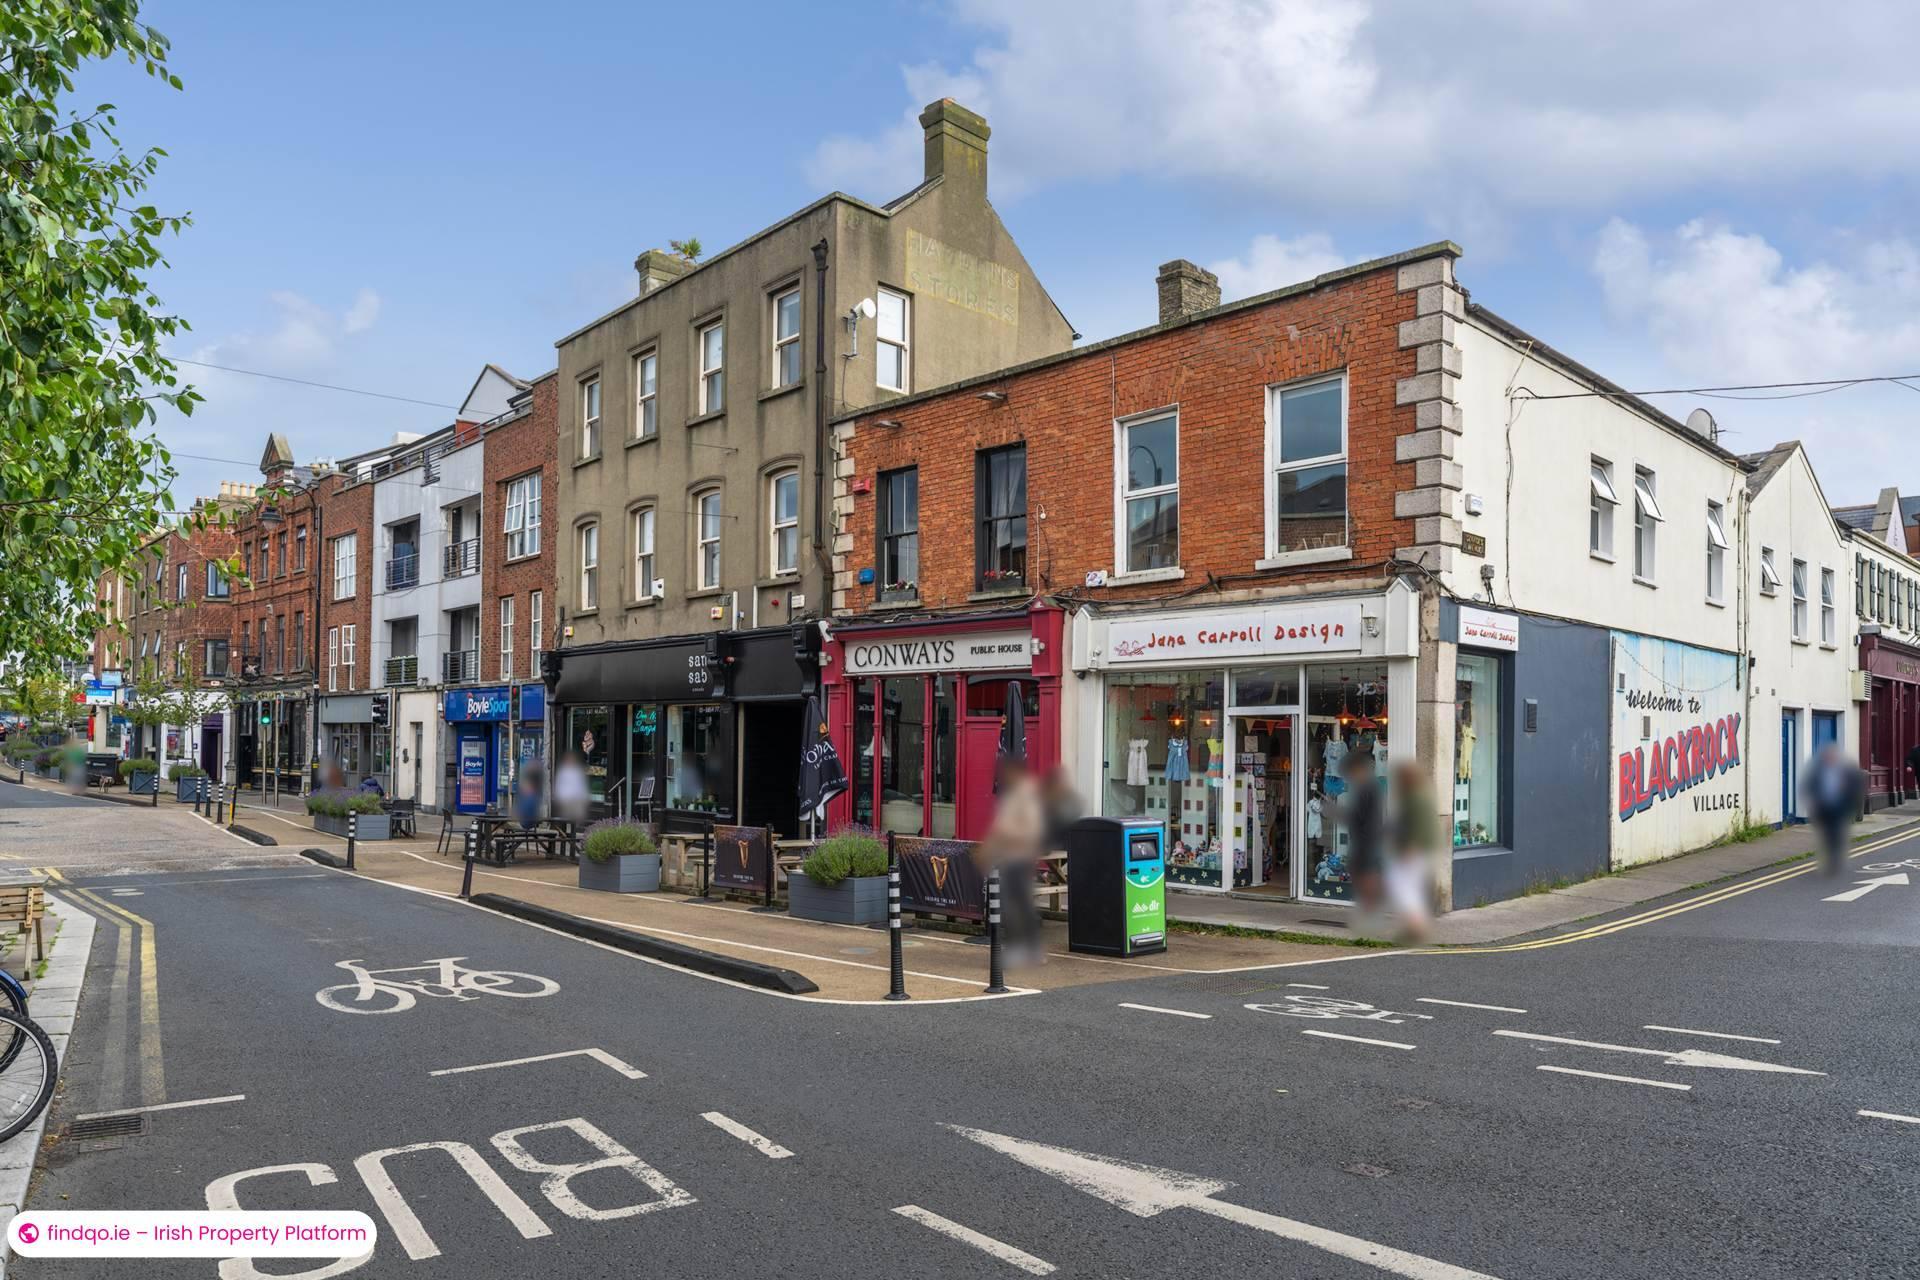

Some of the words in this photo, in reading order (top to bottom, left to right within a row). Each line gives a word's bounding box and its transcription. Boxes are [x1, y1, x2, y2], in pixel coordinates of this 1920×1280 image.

[911, 271, 1015, 322] STORES
[1198, 626, 1261, 644] Carroll
[1274, 623, 1344, 644] Design
[854, 640, 954, 668] CONWAYS
[970, 646, 996, 655] PUBLIC
[998, 644, 1023, 653] HOUSE
[467, 697, 509, 717] BoyleSpor
[1625, 689, 1684, 713] Welcome
[1688, 696, 1701, 714] to
[1619, 712, 1741, 822] BLACKROCK
[1693, 793, 1740, 812] VILLAGE
